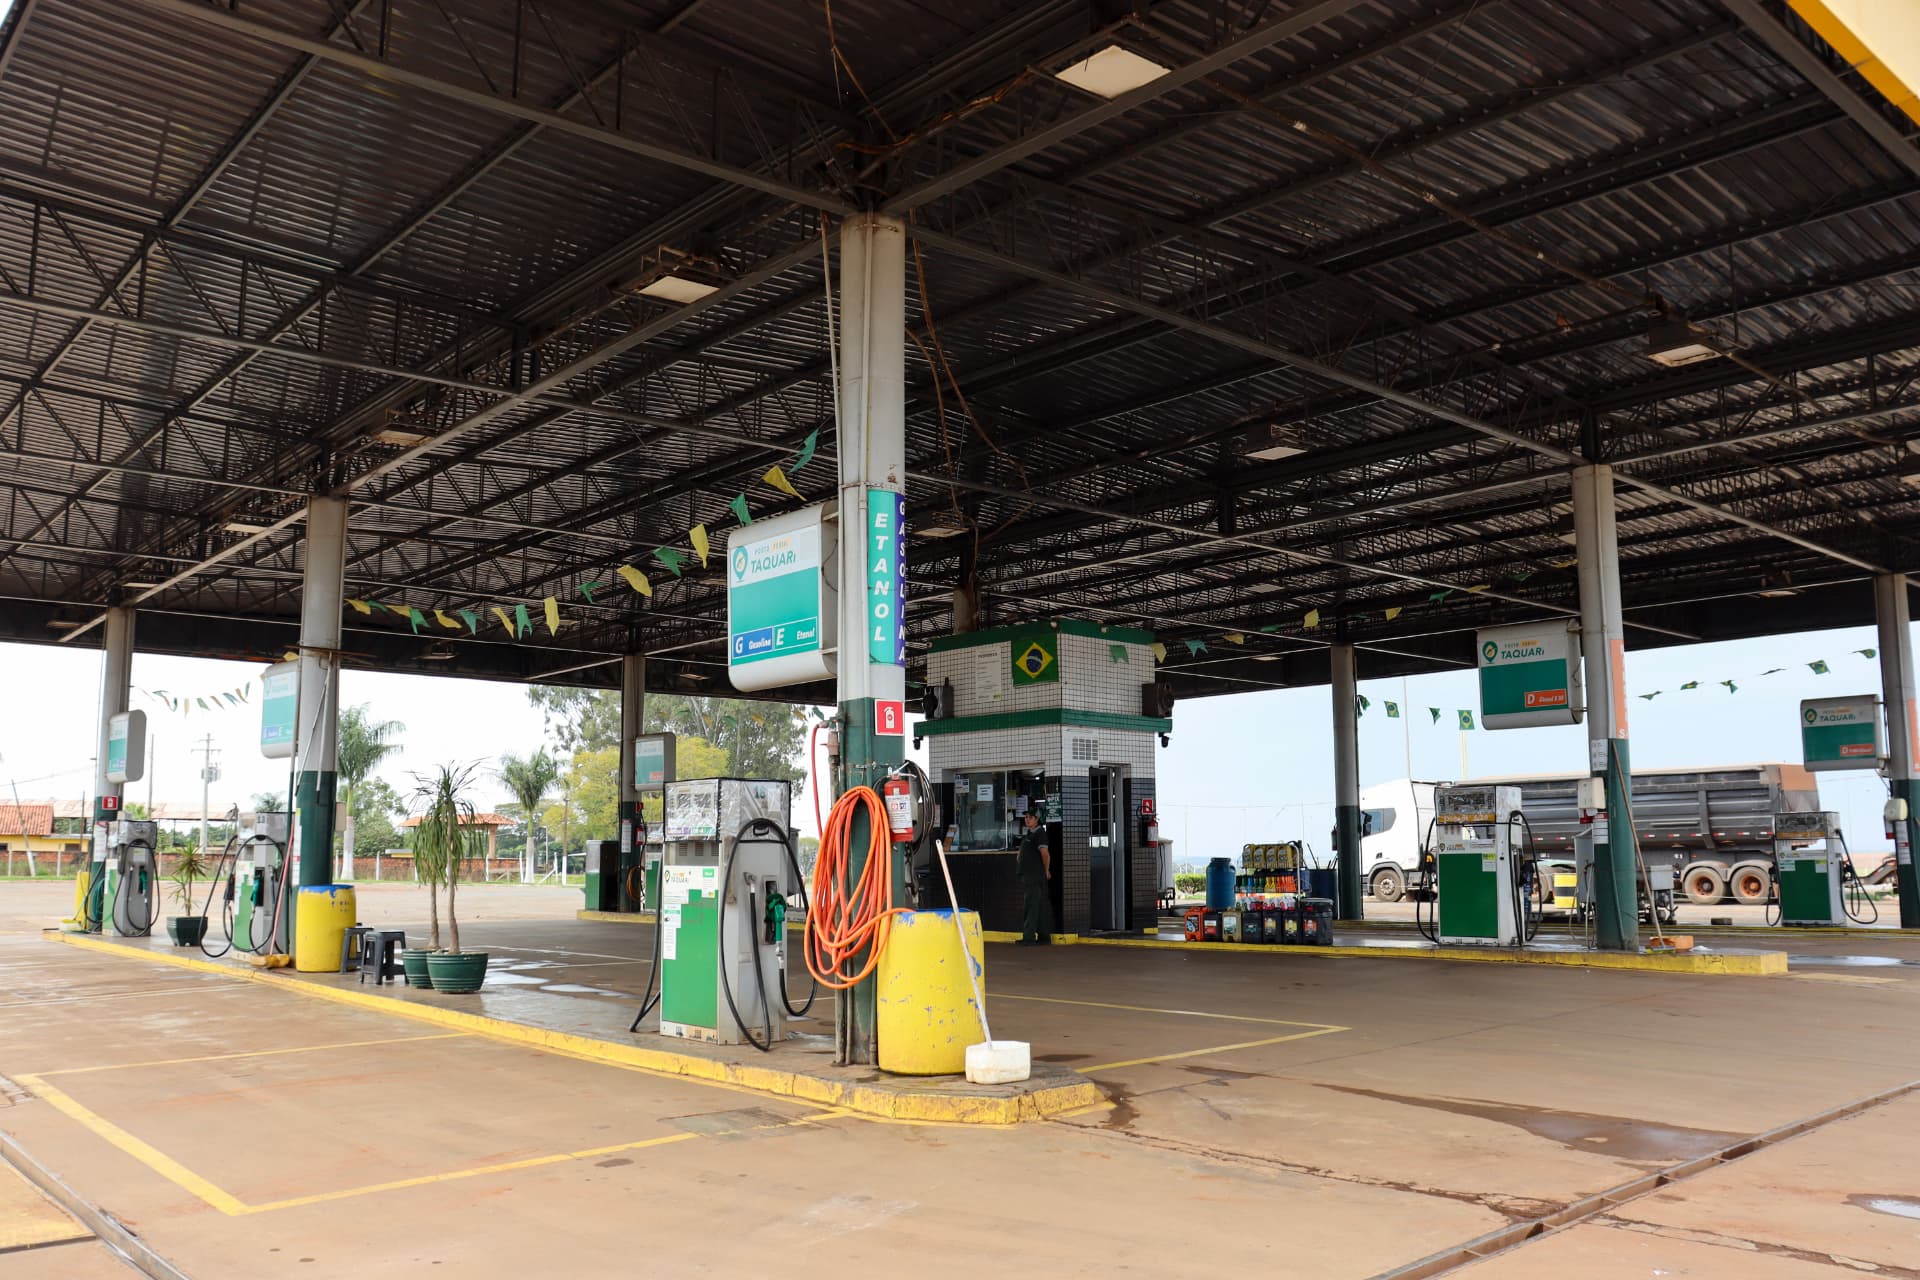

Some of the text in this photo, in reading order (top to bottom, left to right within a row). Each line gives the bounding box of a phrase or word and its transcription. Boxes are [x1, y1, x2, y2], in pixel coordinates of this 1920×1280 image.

[751, 550, 796, 574] TAQUARI
[873, 513, 890, 642] ETANOL
[735, 636, 744, 654] G
[776, 628, 785, 646] E
[1501, 647, 1545, 659] TAQUARI
